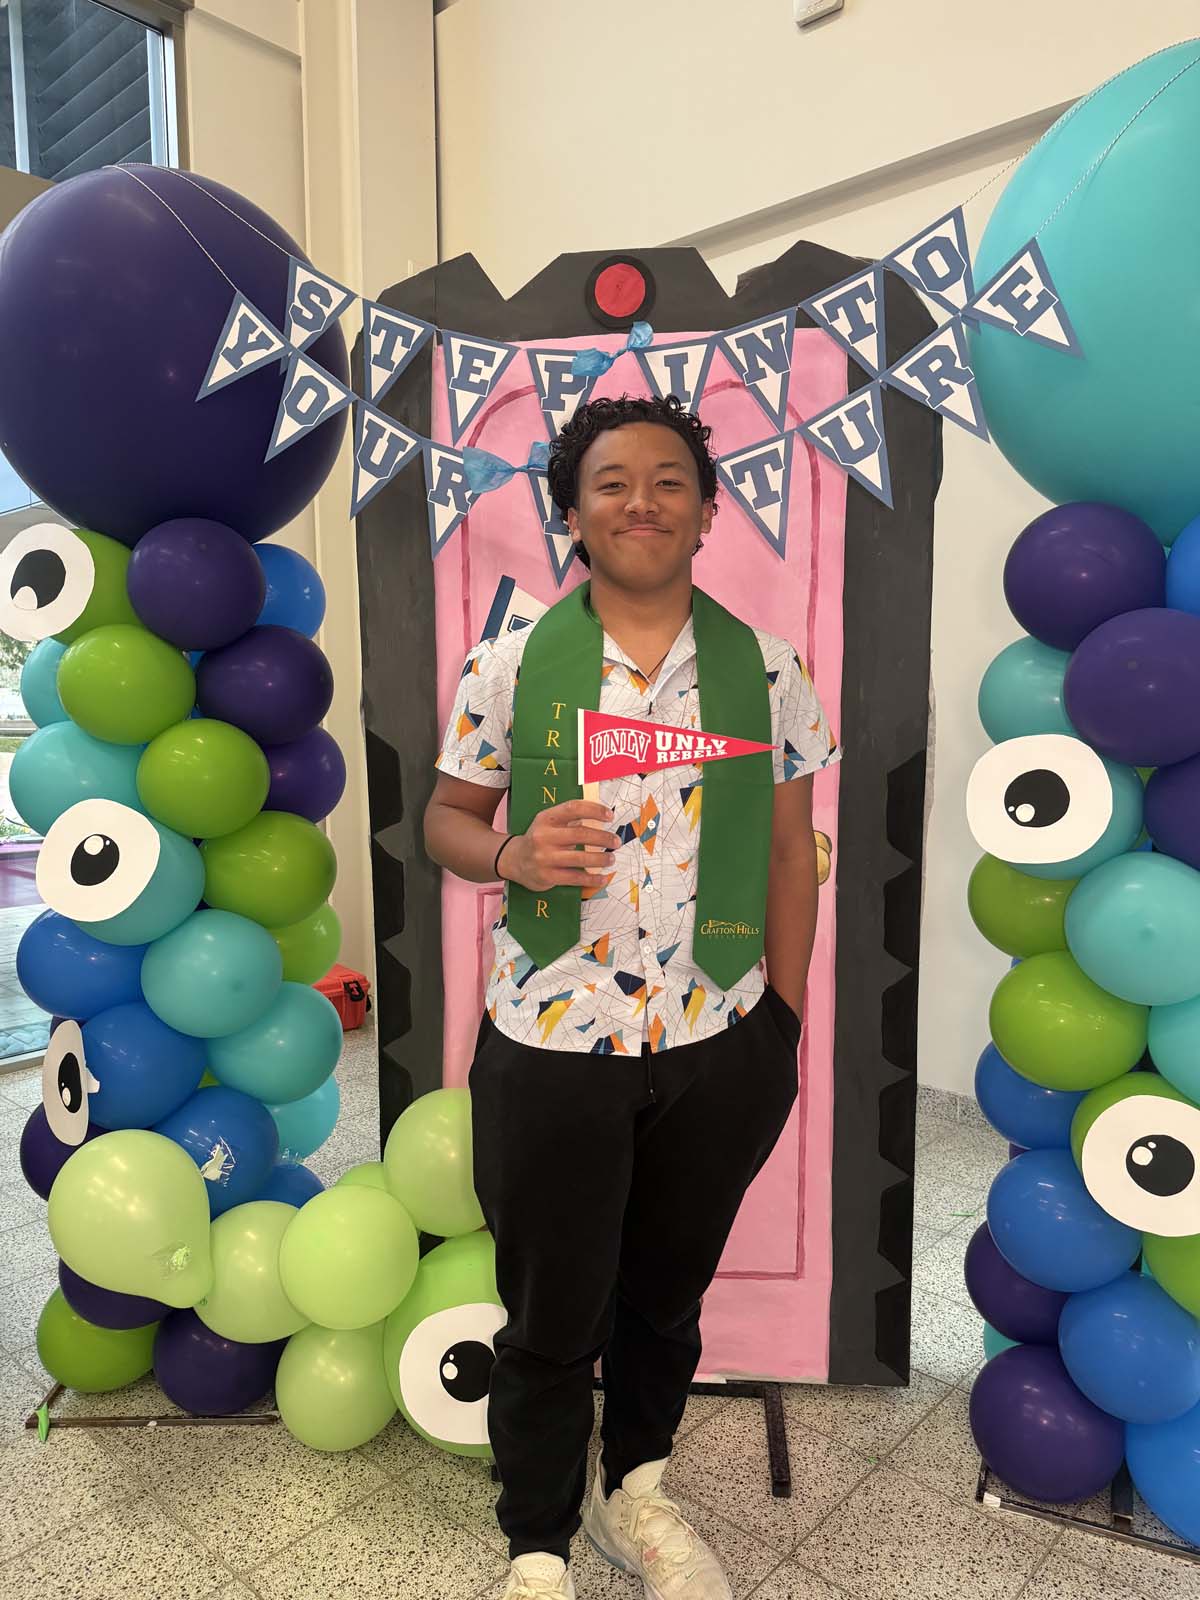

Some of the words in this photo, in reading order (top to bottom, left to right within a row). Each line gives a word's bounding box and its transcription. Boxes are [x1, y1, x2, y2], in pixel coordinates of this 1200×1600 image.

[288, 279, 589, 411] STEP
[662, 235, 967, 404] INTO
[220, 314, 472, 515] YOUR
[589, 728, 652, 766] UNLV
[655, 730, 729, 751] UNLV
[656, 748, 729, 764] REBELS
[536, 702, 567, 919] TRANR
